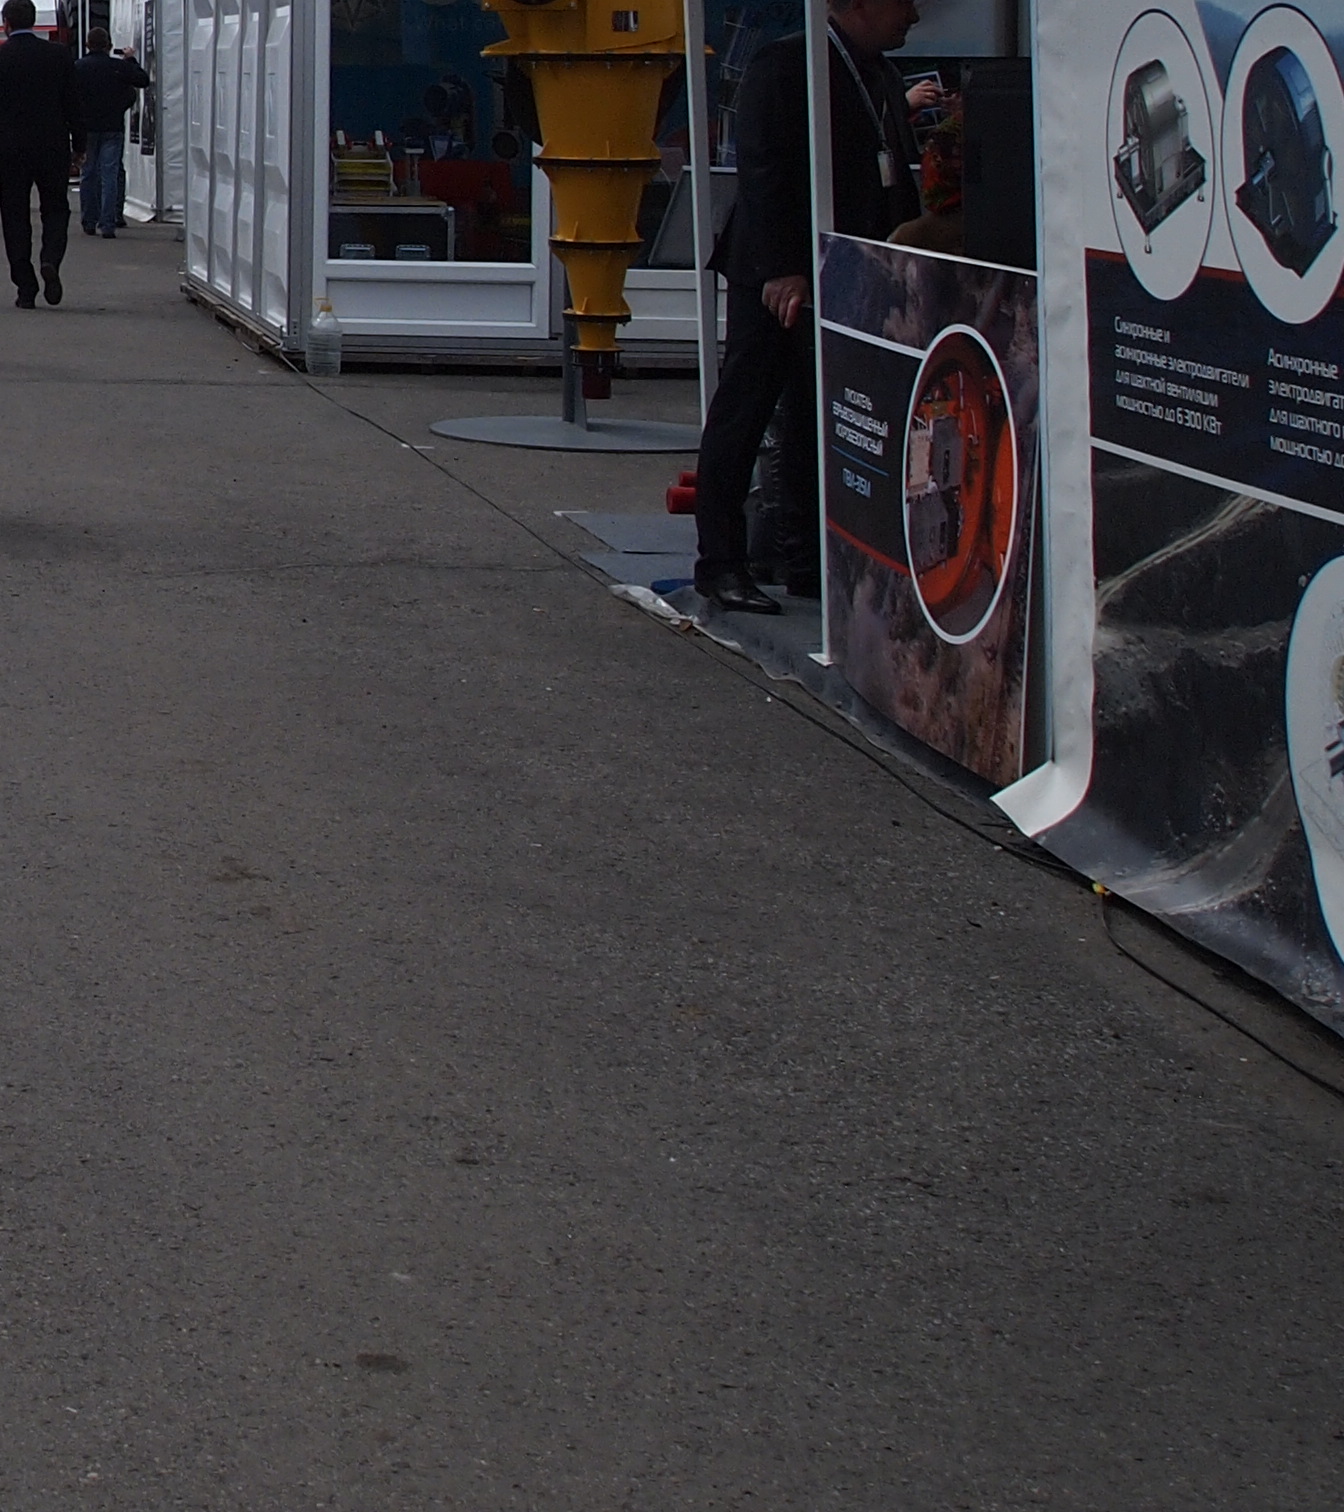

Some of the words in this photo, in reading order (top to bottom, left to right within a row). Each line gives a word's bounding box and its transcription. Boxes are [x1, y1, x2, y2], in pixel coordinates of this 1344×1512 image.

[1267, 348, 1339, 381] Асинхронные
[1268, 409, 1287, 426] для
[1289, 412, 1340, 439] шахтного
[1269, 436, 1332, 465] мощностью
